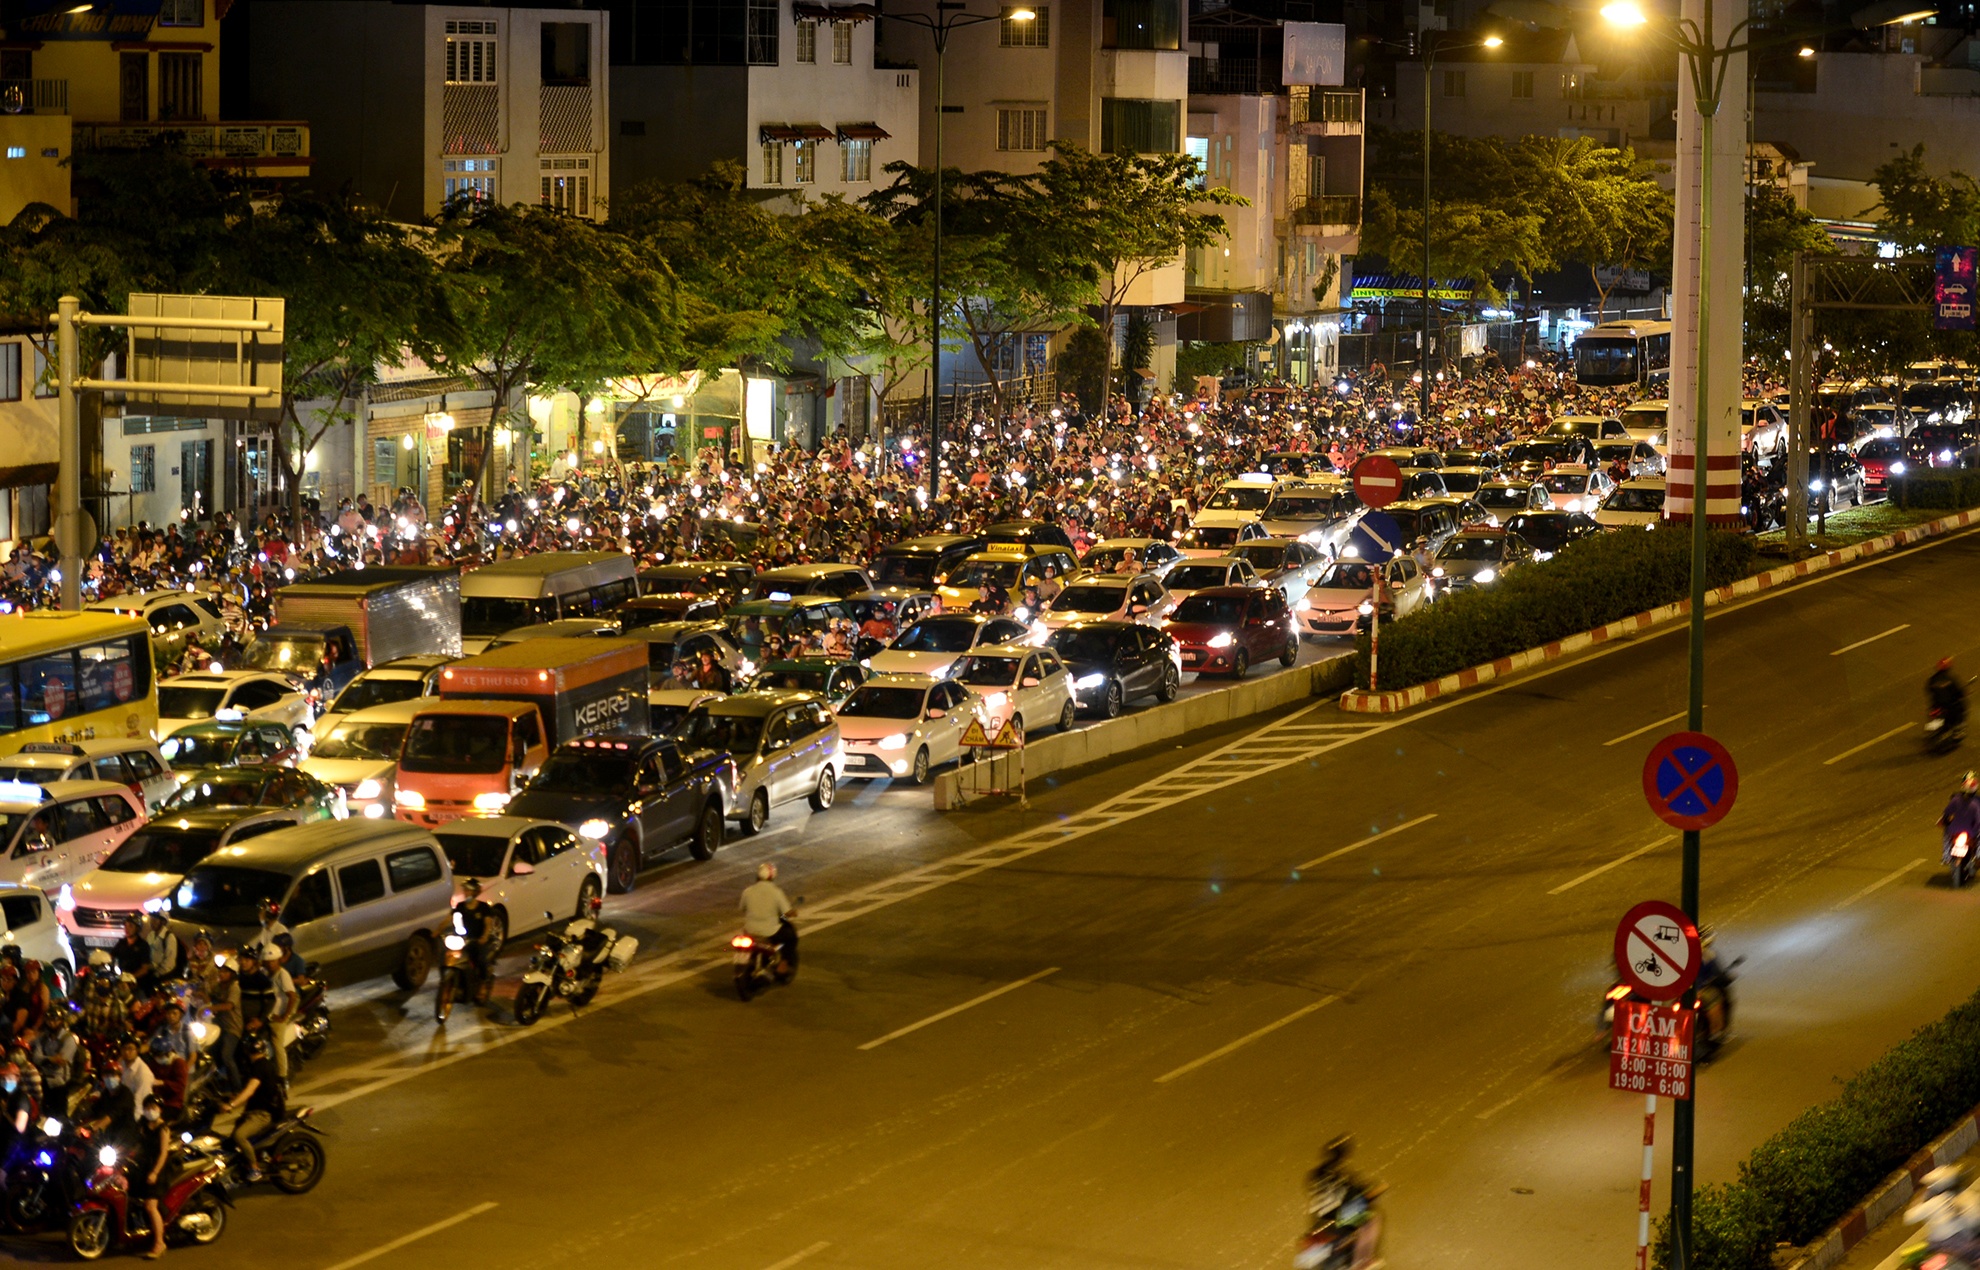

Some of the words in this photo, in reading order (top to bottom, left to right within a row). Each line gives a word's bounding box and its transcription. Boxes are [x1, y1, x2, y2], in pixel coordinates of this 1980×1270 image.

[462, 676, 477, 687] XE
[575, 692, 630, 727] KERRY
[583, 717, 623, 735] EXPRESS
[1630, 1007, 1677, 1038] CẤM
[1617, 1036, 1629, 1052] XE
[1631, 1038, 1637, 1053] 2
[1640, 1037, 1651, 1055] VÀ
[1654, 1041, 1660, 1056] 3
[1659, 1079, 1686, 1096] 6:00
